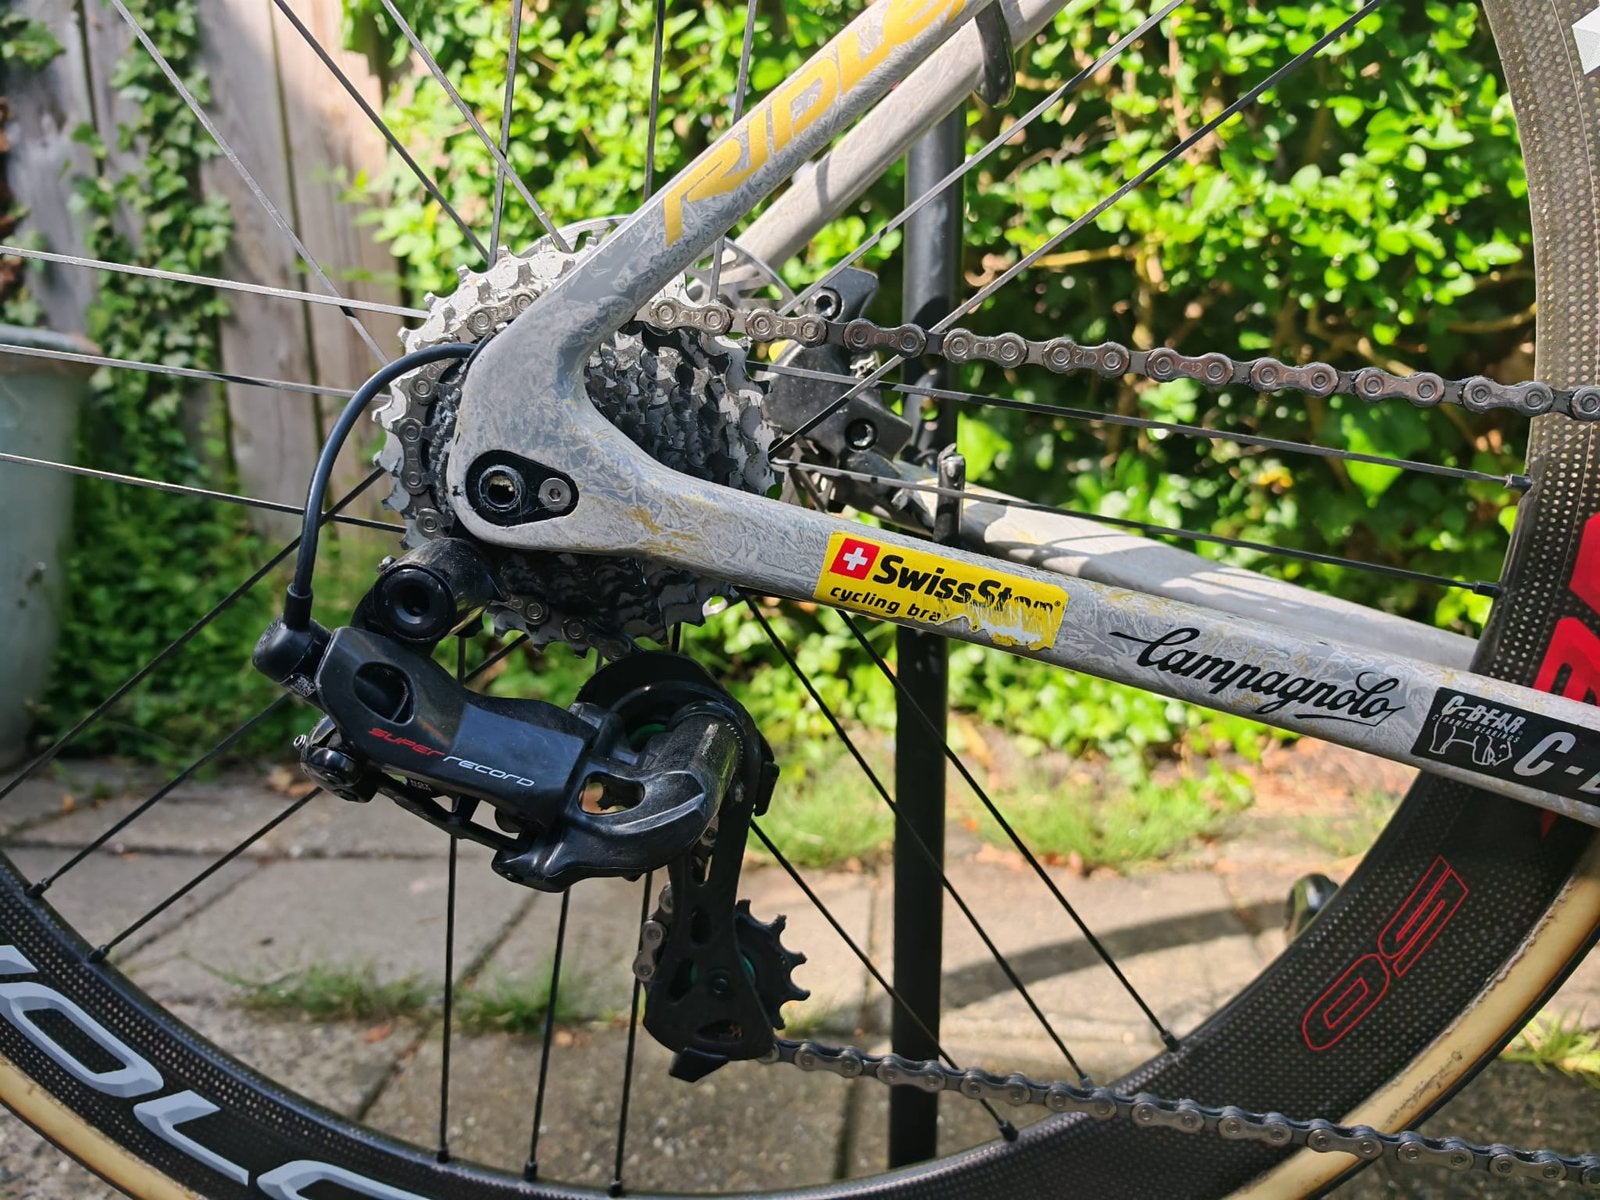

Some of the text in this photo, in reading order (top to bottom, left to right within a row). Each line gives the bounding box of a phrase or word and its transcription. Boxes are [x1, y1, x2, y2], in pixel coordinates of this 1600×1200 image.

[663, 0, 967, 247] RIDLE
[830, 586, 900, 614] cycling
[1108, 627, 1406, 727] Campagnolo
[1441, 694, 1527, 734] C-BEAR
[1473, 725, 1522, 744] BEARINGS
[1512, 731, 1600, 796] C-
[1301, 854, 1470, 1051] 50
